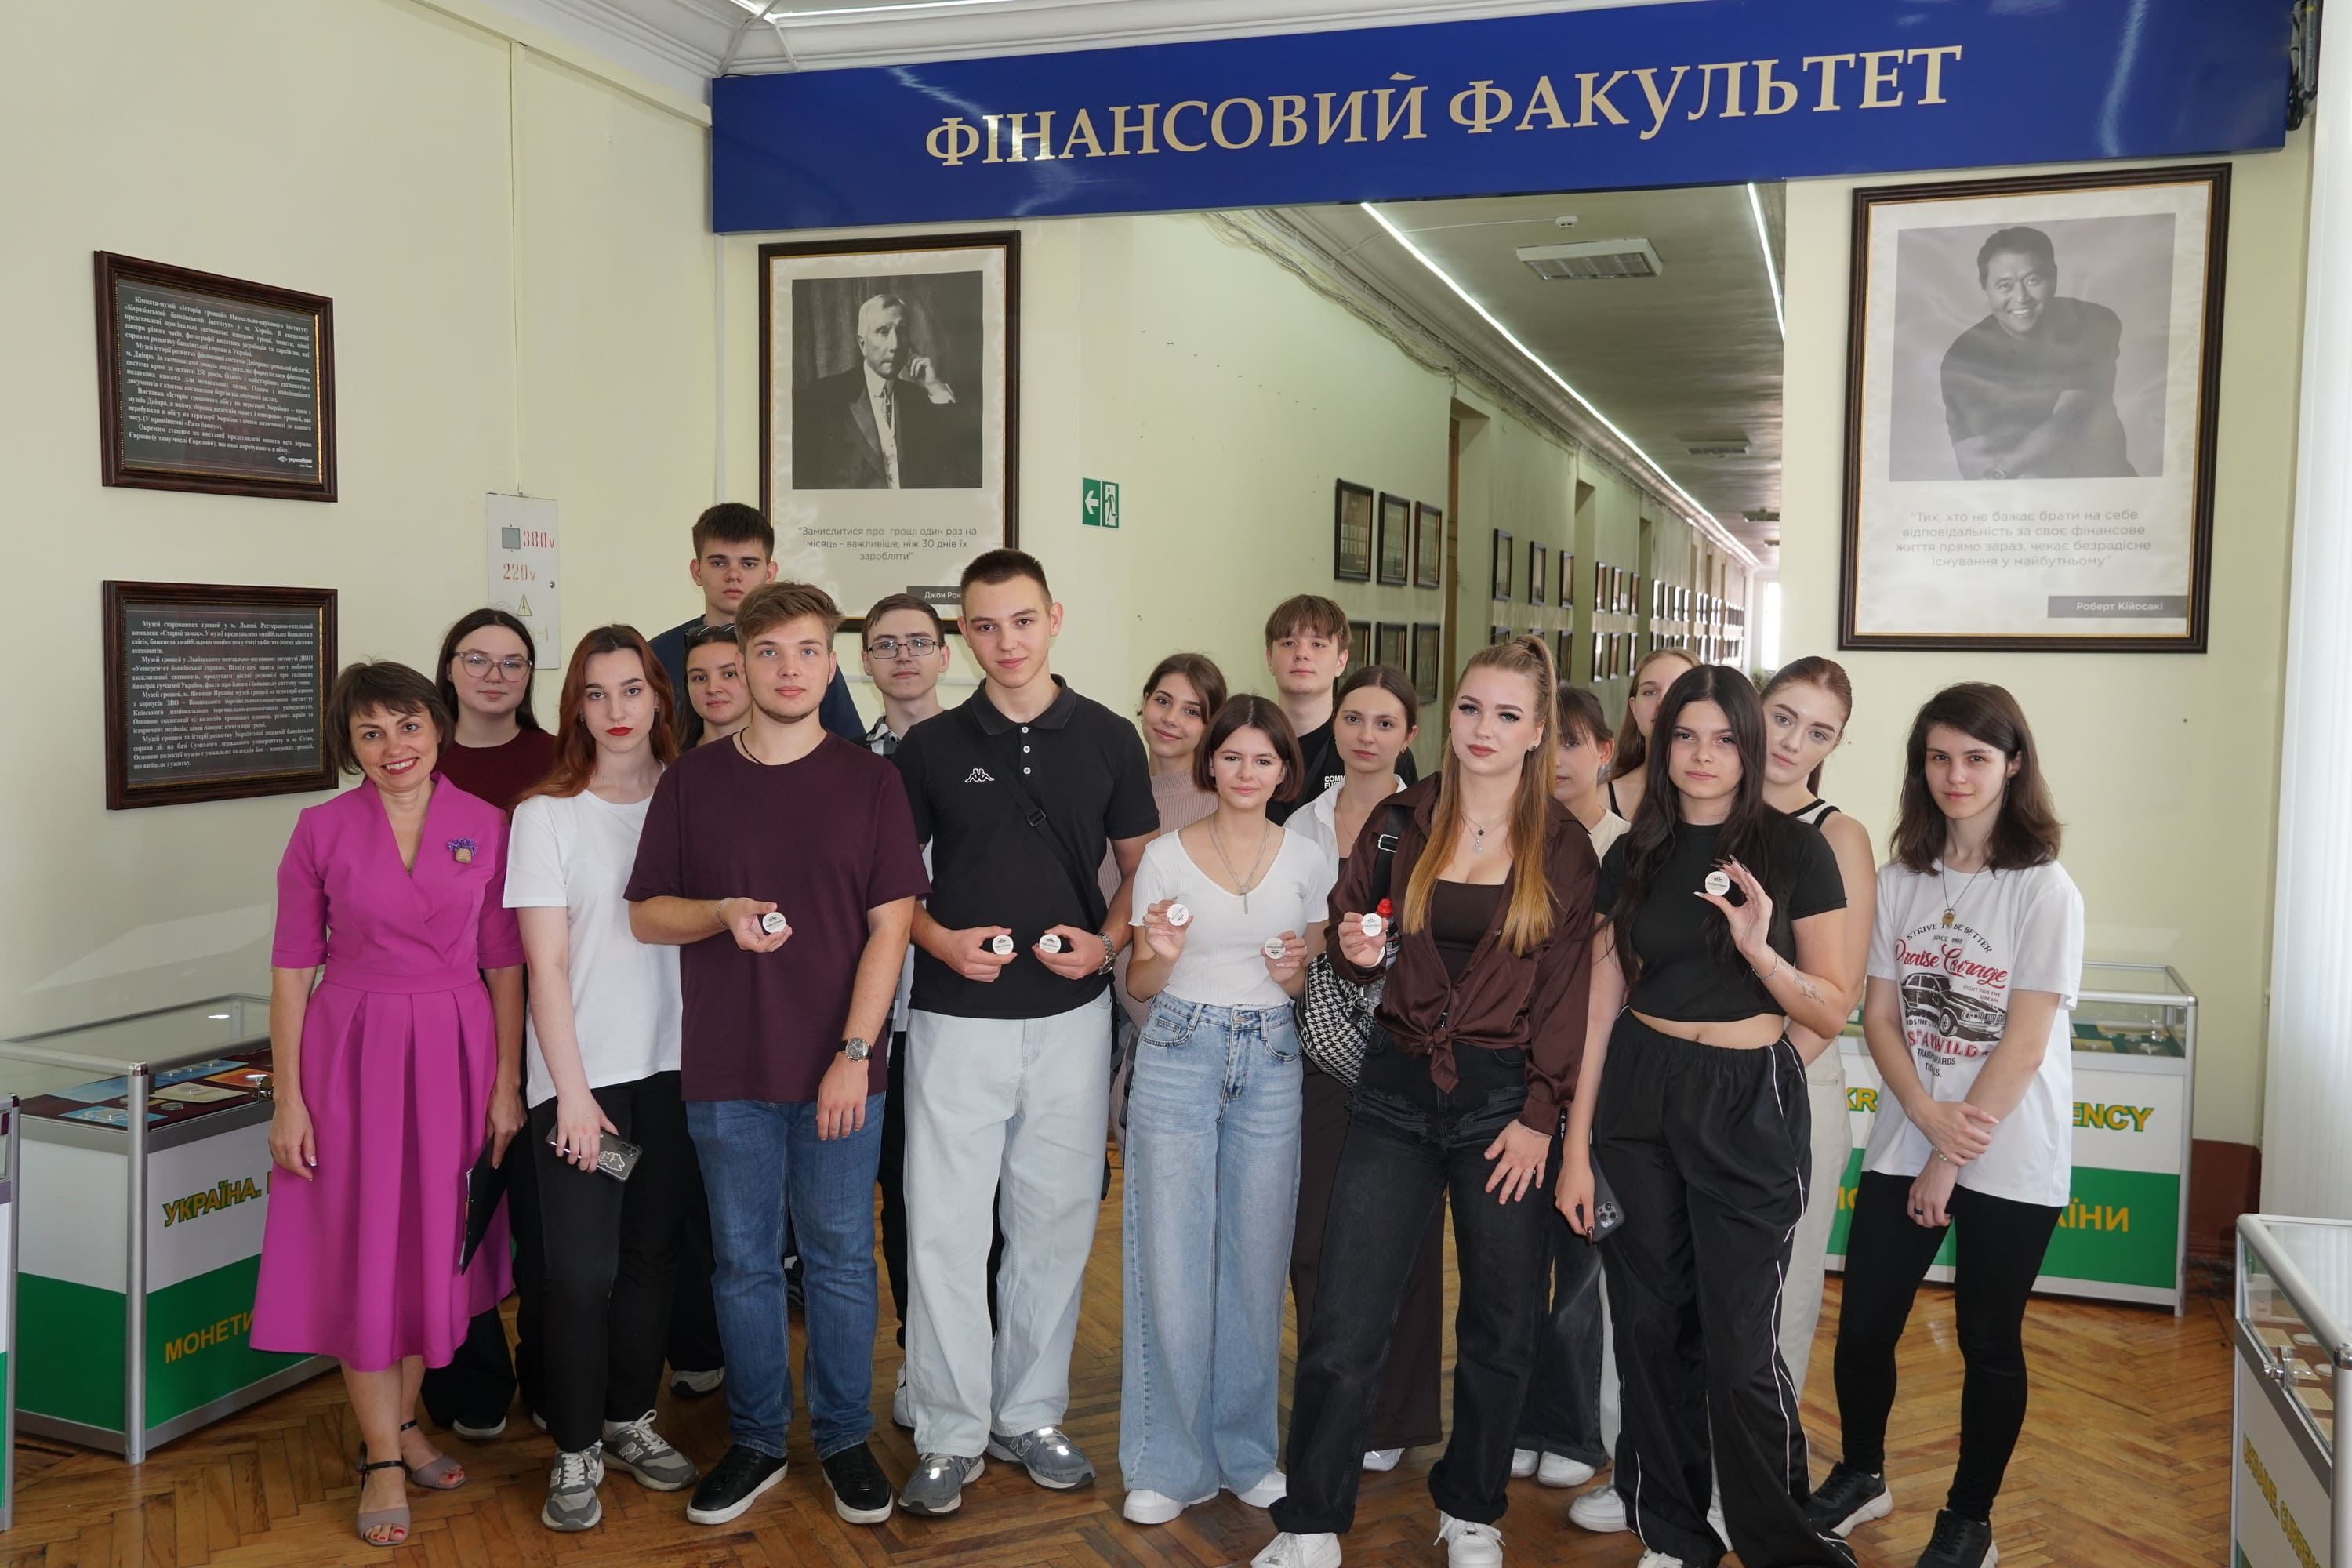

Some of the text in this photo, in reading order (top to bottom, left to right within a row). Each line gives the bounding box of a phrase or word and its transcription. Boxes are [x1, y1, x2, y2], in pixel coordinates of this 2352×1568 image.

[926, 45, 1962, 165] ФІНАНСОВИЙ ФАКУЛЬТЕТ
[1992, 511, 2035, 521] бажає
[2039, 511, 2080, 522] брати
[2105, 510, 2138, 520] себе
[890, 527, 917, 536] гроші
[1902, 526, 2145, 538] відповідальність за своє фінансове
[807, 539, 837, 548] місяць
[846, 540, 900, 549] важливіше,
[903, 539, 918, 548] ніж
[922, 539, 934, 548] 30
[936, 539, 957, 549] днів
[959, 539, 968, 548] їх
[1895, 541, 2152, 553] життя прямо зараз, чекає безрадісне
[1932, 556, 1998, 568] існування
[2002, 558, 2009, 568] у
[924, 591, 946, 599] Джон
[2076, 601, 2163, 612] Роберт Кійосакі
[1907, 923, 1938, 940] STRIVE
[1964, 927, 1993, 953] BETTER
[1980, 995, 1999, 1003] DREAM
